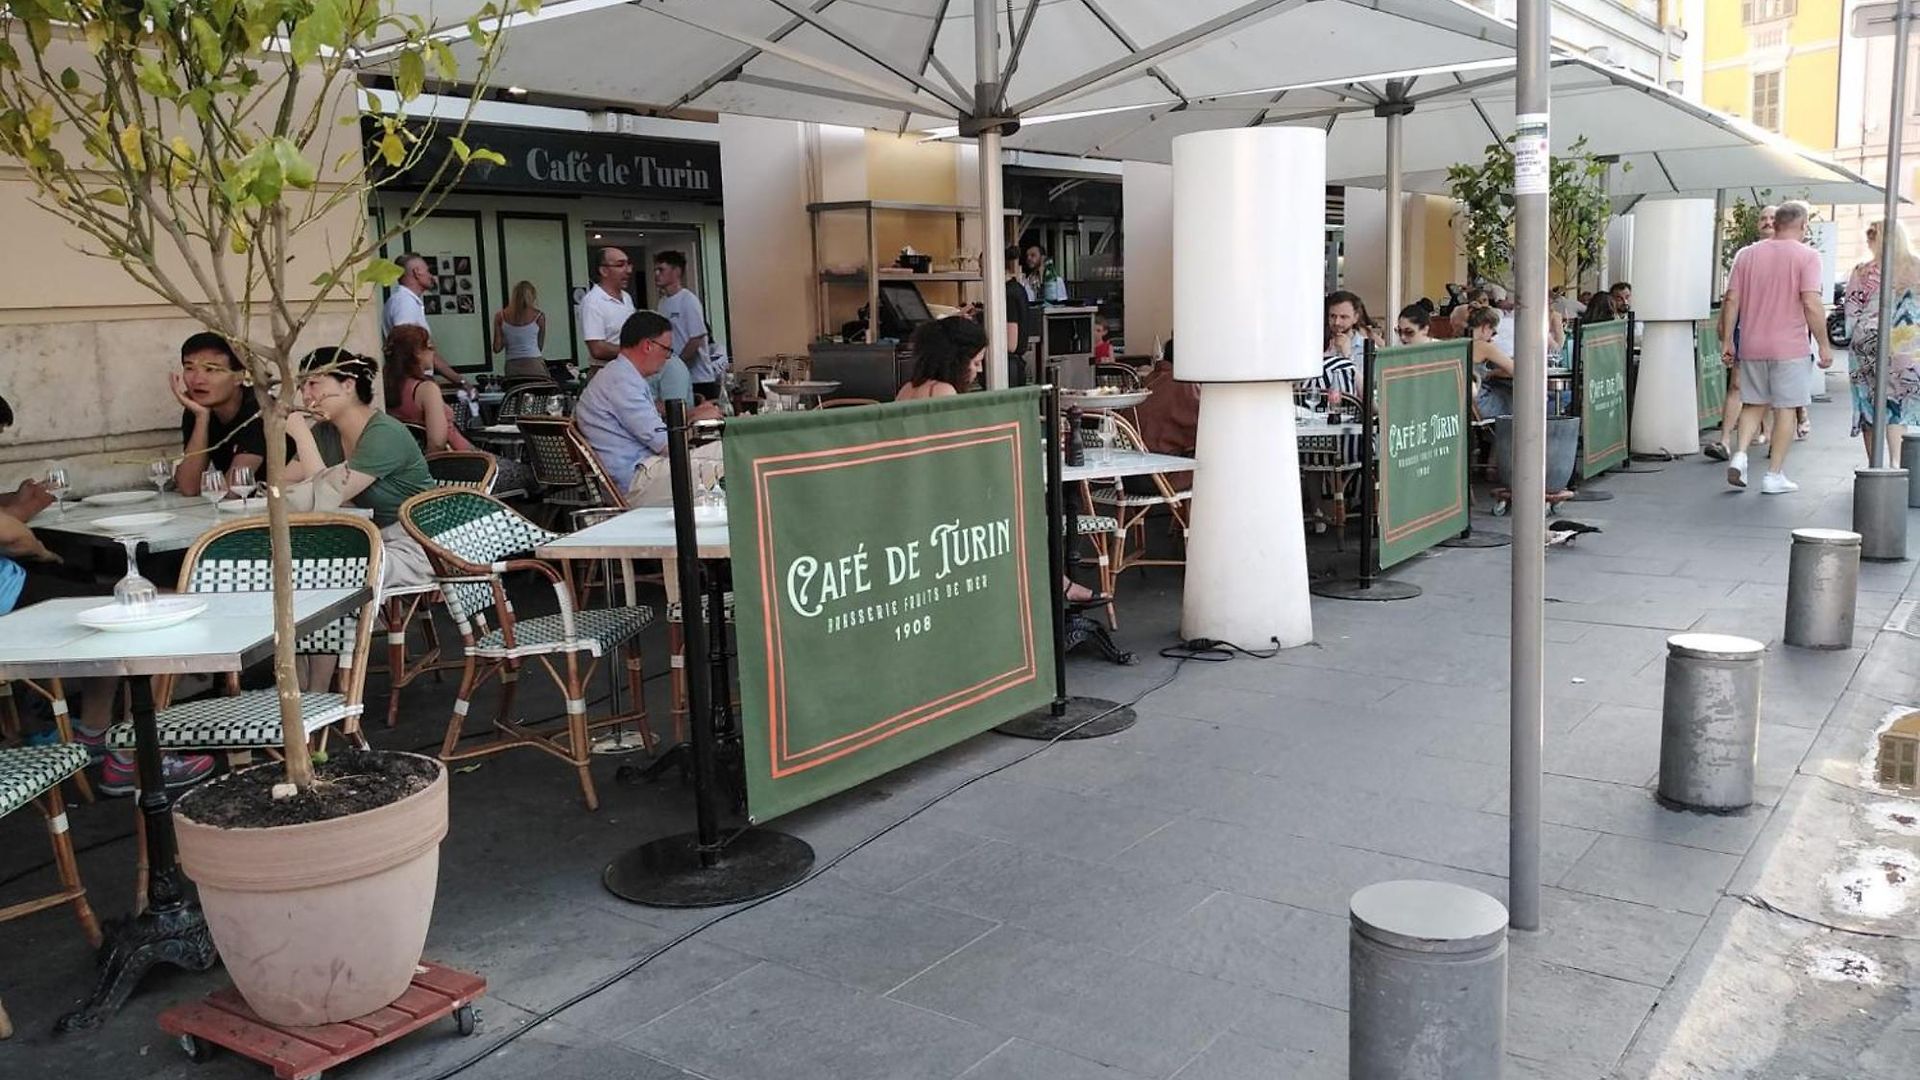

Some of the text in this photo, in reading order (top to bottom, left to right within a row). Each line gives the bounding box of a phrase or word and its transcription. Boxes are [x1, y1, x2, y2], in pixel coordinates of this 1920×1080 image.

[526, 147, 709, 190] Café de Turin
[1389, 420, 1415, 458] CAFÉ
[1430, 412, 1459, 446] TURIN
[786, 518, 1011, 618] CAFÉ DE TURIN
[827, 574, 988, 634] BRASSERIE FRUITS DE MER
[895, 615, 932, 642] 1908
